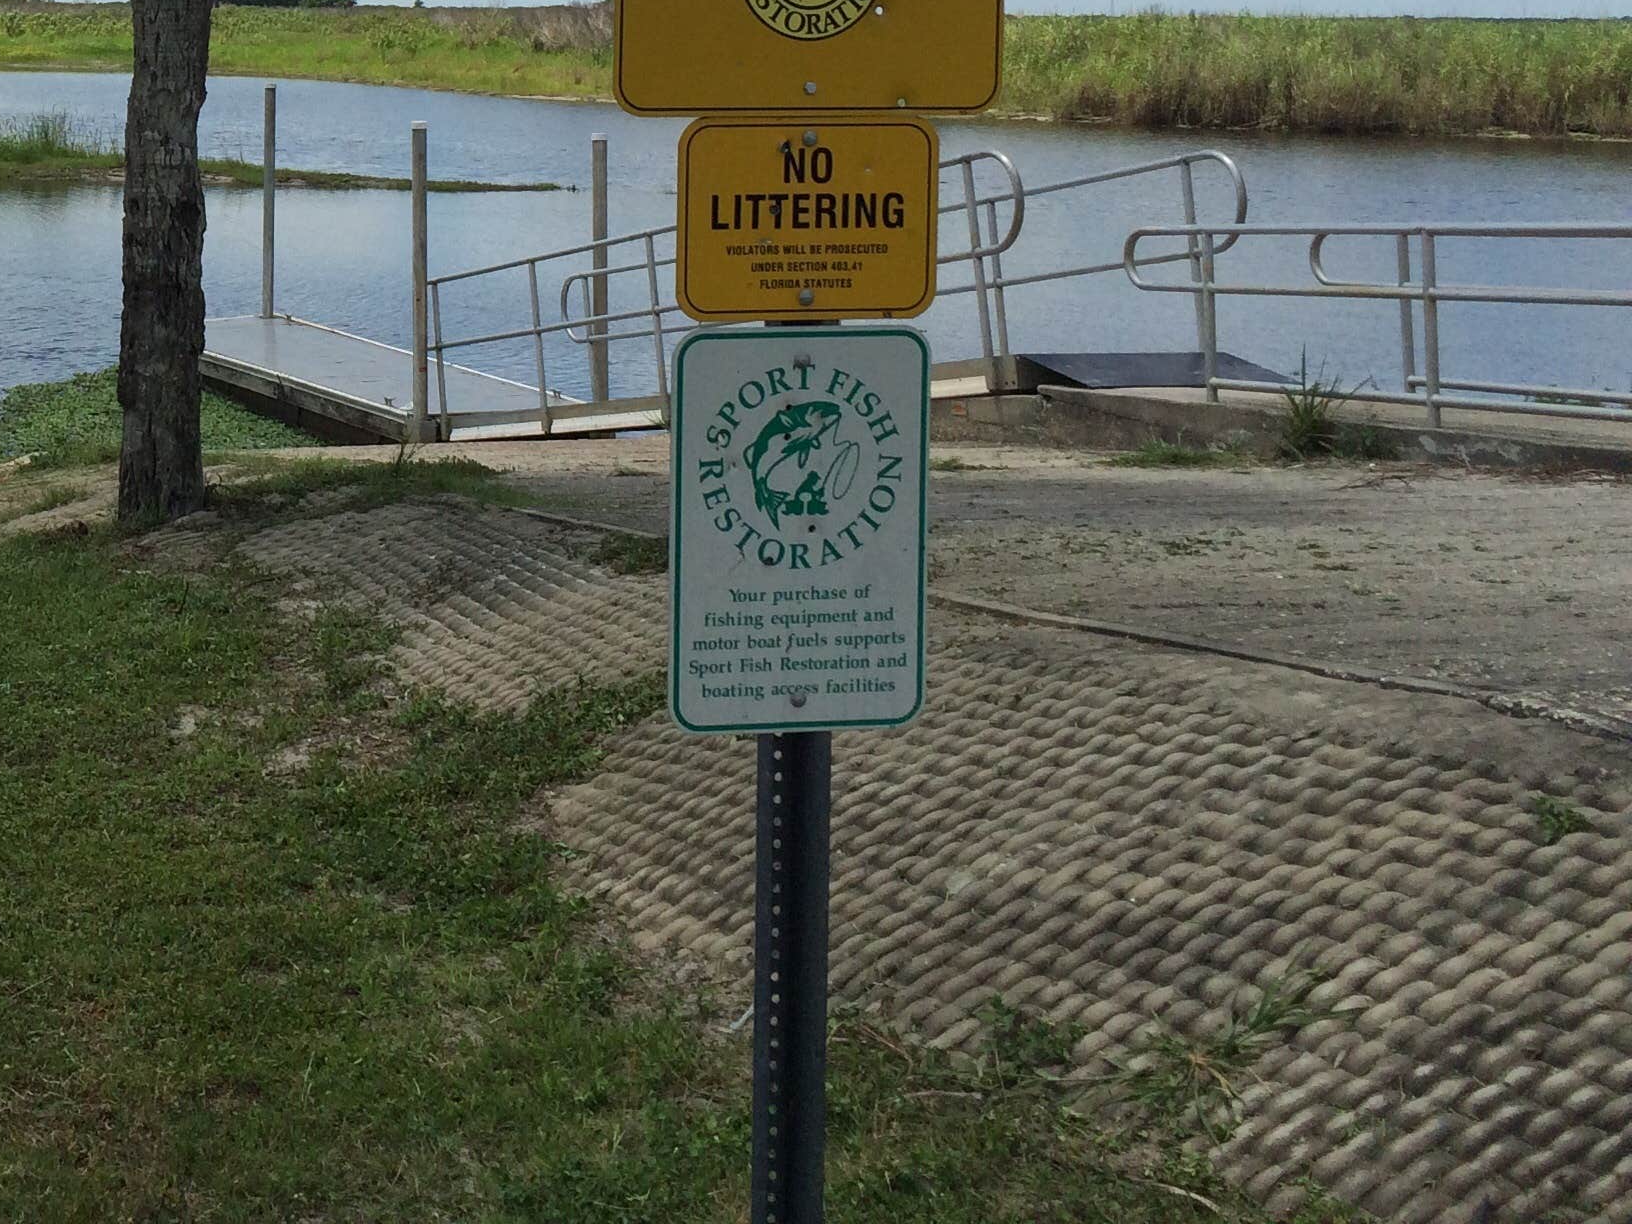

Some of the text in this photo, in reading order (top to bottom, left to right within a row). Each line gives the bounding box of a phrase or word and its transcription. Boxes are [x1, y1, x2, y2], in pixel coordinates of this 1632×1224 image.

[783, 146, 833, 184] NO
[711, 192, 905, 230] LITTERING
[726, 243, 889, 256] VIOLATORS WILL BE PROSECUTED
[751, 262, 784, 273] UNDER
[787, 261, 828, 272] SECTION
[759, 278, 852, 289] FLORIDA STATUTES
[706, 363, 900, 449] SPORT FISH
[698, 453, 903, 570] RESTORATION
[728, 584, 872, 606] Your purchase of
[704, 607, 895, 629] fishing equipment and
[692, 631, 906, 652] motor boat fuels supports
[688, 652, 908, 678] Sport Fish Restoration and
[701, 678, 896, 701] boating access facilities
